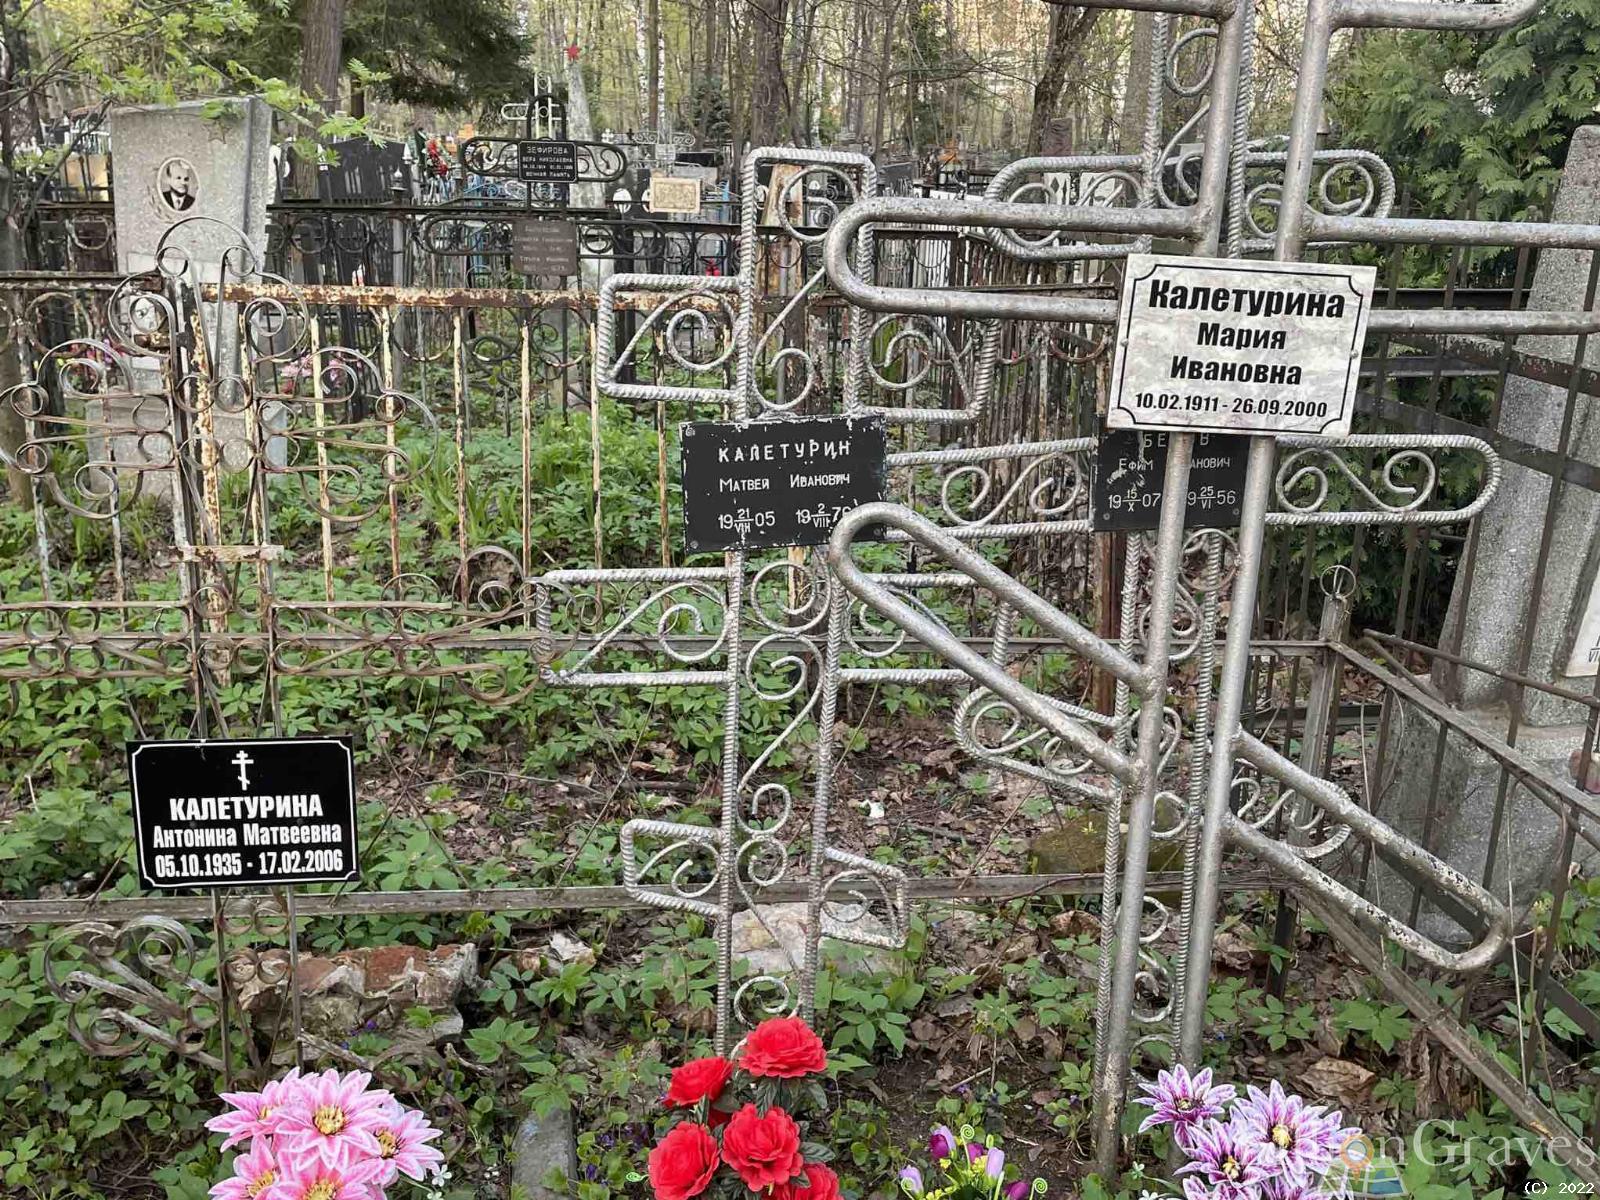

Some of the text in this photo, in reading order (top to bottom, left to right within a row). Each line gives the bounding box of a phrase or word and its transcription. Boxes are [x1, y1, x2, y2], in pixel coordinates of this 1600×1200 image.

[527, 146, 568, 155] ЗЕФИРОВА
[1149, 279, 1346, 318] Калетурина
[1197, 322, 1287, 350] Мария
[1170, 355, 1302, 385] Ивановна
[1135, 393, 1219, 412] 10.02.1911
[1232, 398, 1328, 418] 26.09.2000
[718, 440, 851, 463] КАЛЕТУРИН
[170, 794, 323, 821] КАЛЕТУРИНА
[153, 823, 342, 848] Антонина Матвеевна
[155, 853, 242, 877] 05.10.1935
[259, 849, 344, 874] 17.02.2006
